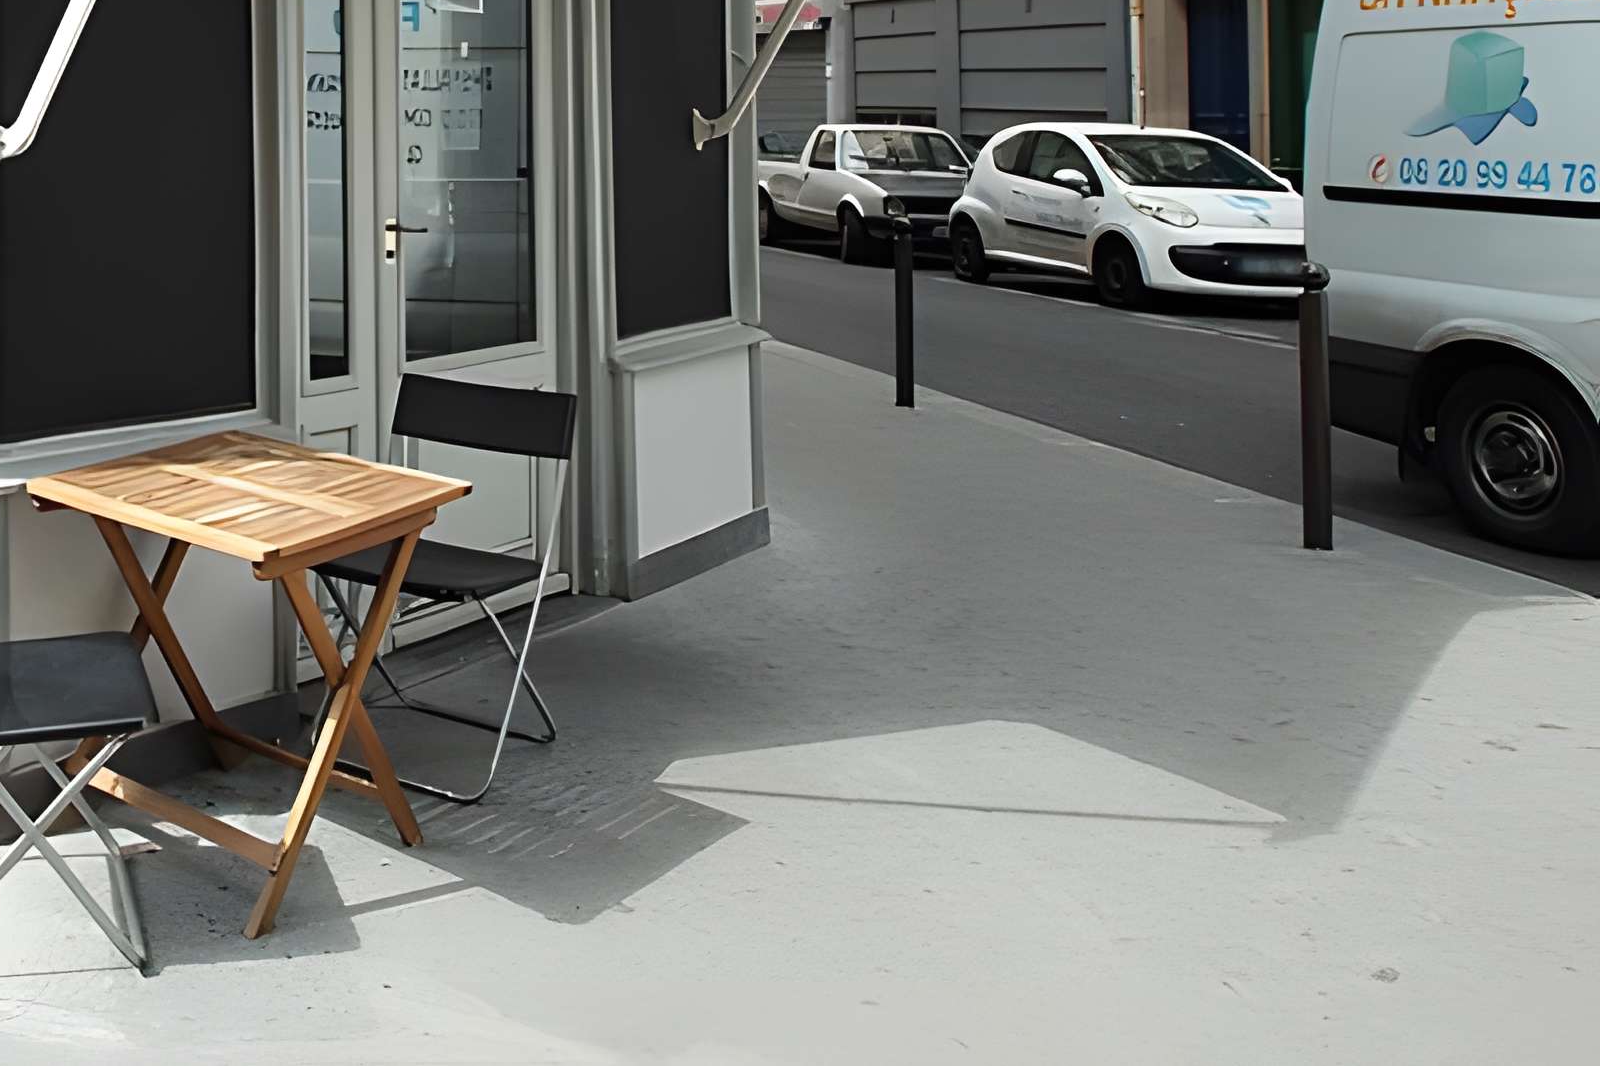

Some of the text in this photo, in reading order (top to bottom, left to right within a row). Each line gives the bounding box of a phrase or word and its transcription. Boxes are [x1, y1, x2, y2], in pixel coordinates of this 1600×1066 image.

[1438, 159, 1467, 186] 20
[1476, 160, 1508, 189] 99
[1517, 161, 1550, 192] 44
